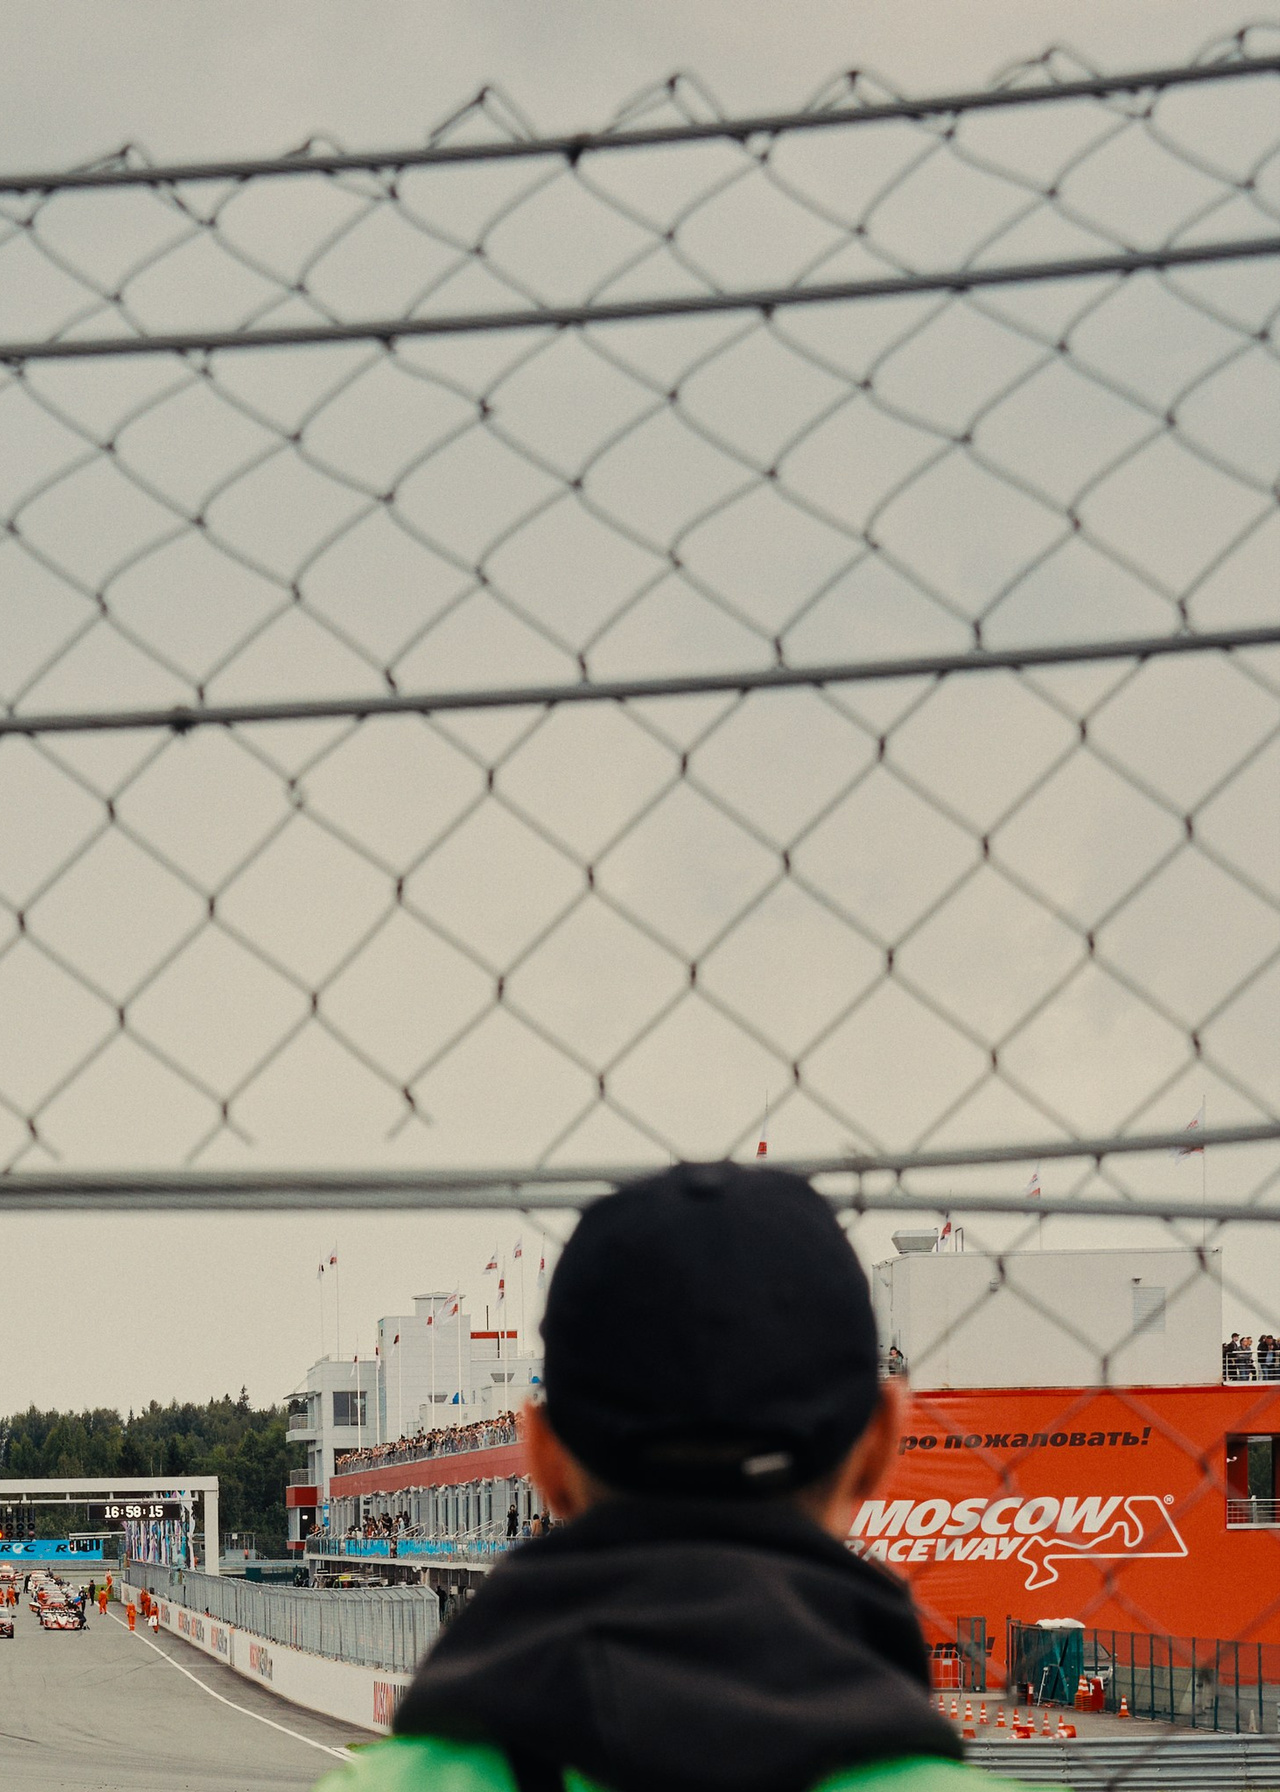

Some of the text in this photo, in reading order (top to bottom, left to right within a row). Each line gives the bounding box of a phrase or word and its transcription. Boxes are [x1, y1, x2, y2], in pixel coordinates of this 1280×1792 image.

[943, 1427, 1152, 1449] пожаловать!
[104, 1505, 164, 1518] 16:58:15
[848, 1496, 1124, 1537] MOSCOW
